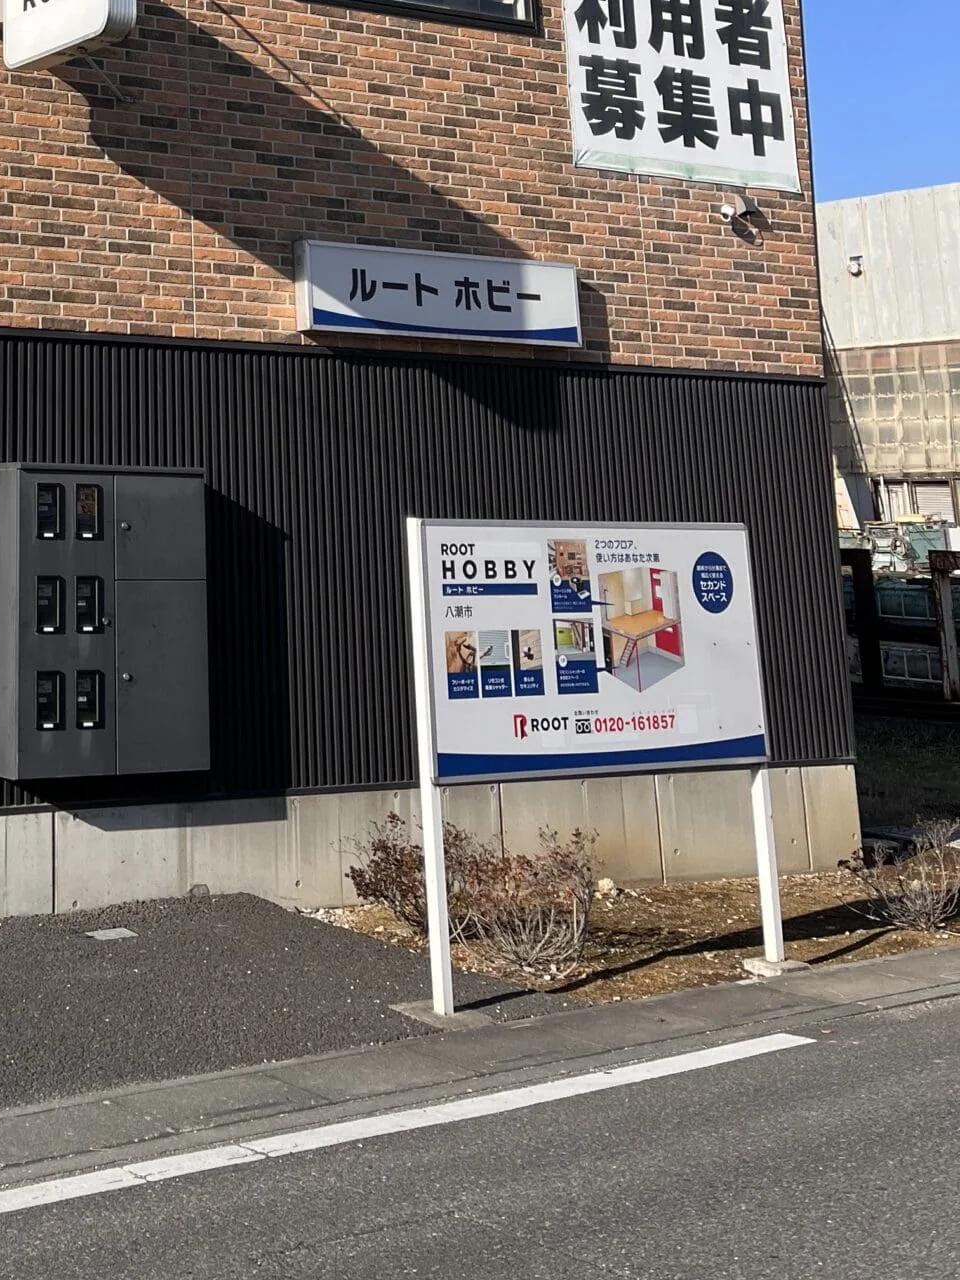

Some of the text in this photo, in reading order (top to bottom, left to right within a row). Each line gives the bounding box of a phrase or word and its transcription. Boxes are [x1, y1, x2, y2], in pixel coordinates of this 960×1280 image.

[579, 54, 785, 157] 募集中
[349, 268, 542, 313] ルート ホビー
[441, 543, 476, 556] ROOT
[442, 560, 536, 580] HOBBY
[700, 580, 727, 590] セカンド
[701, 592, 728, 602] スペース
[445, 605, 473, 618] 八潮市
[531, 714, 676, 733] ROOT 0120-161857
